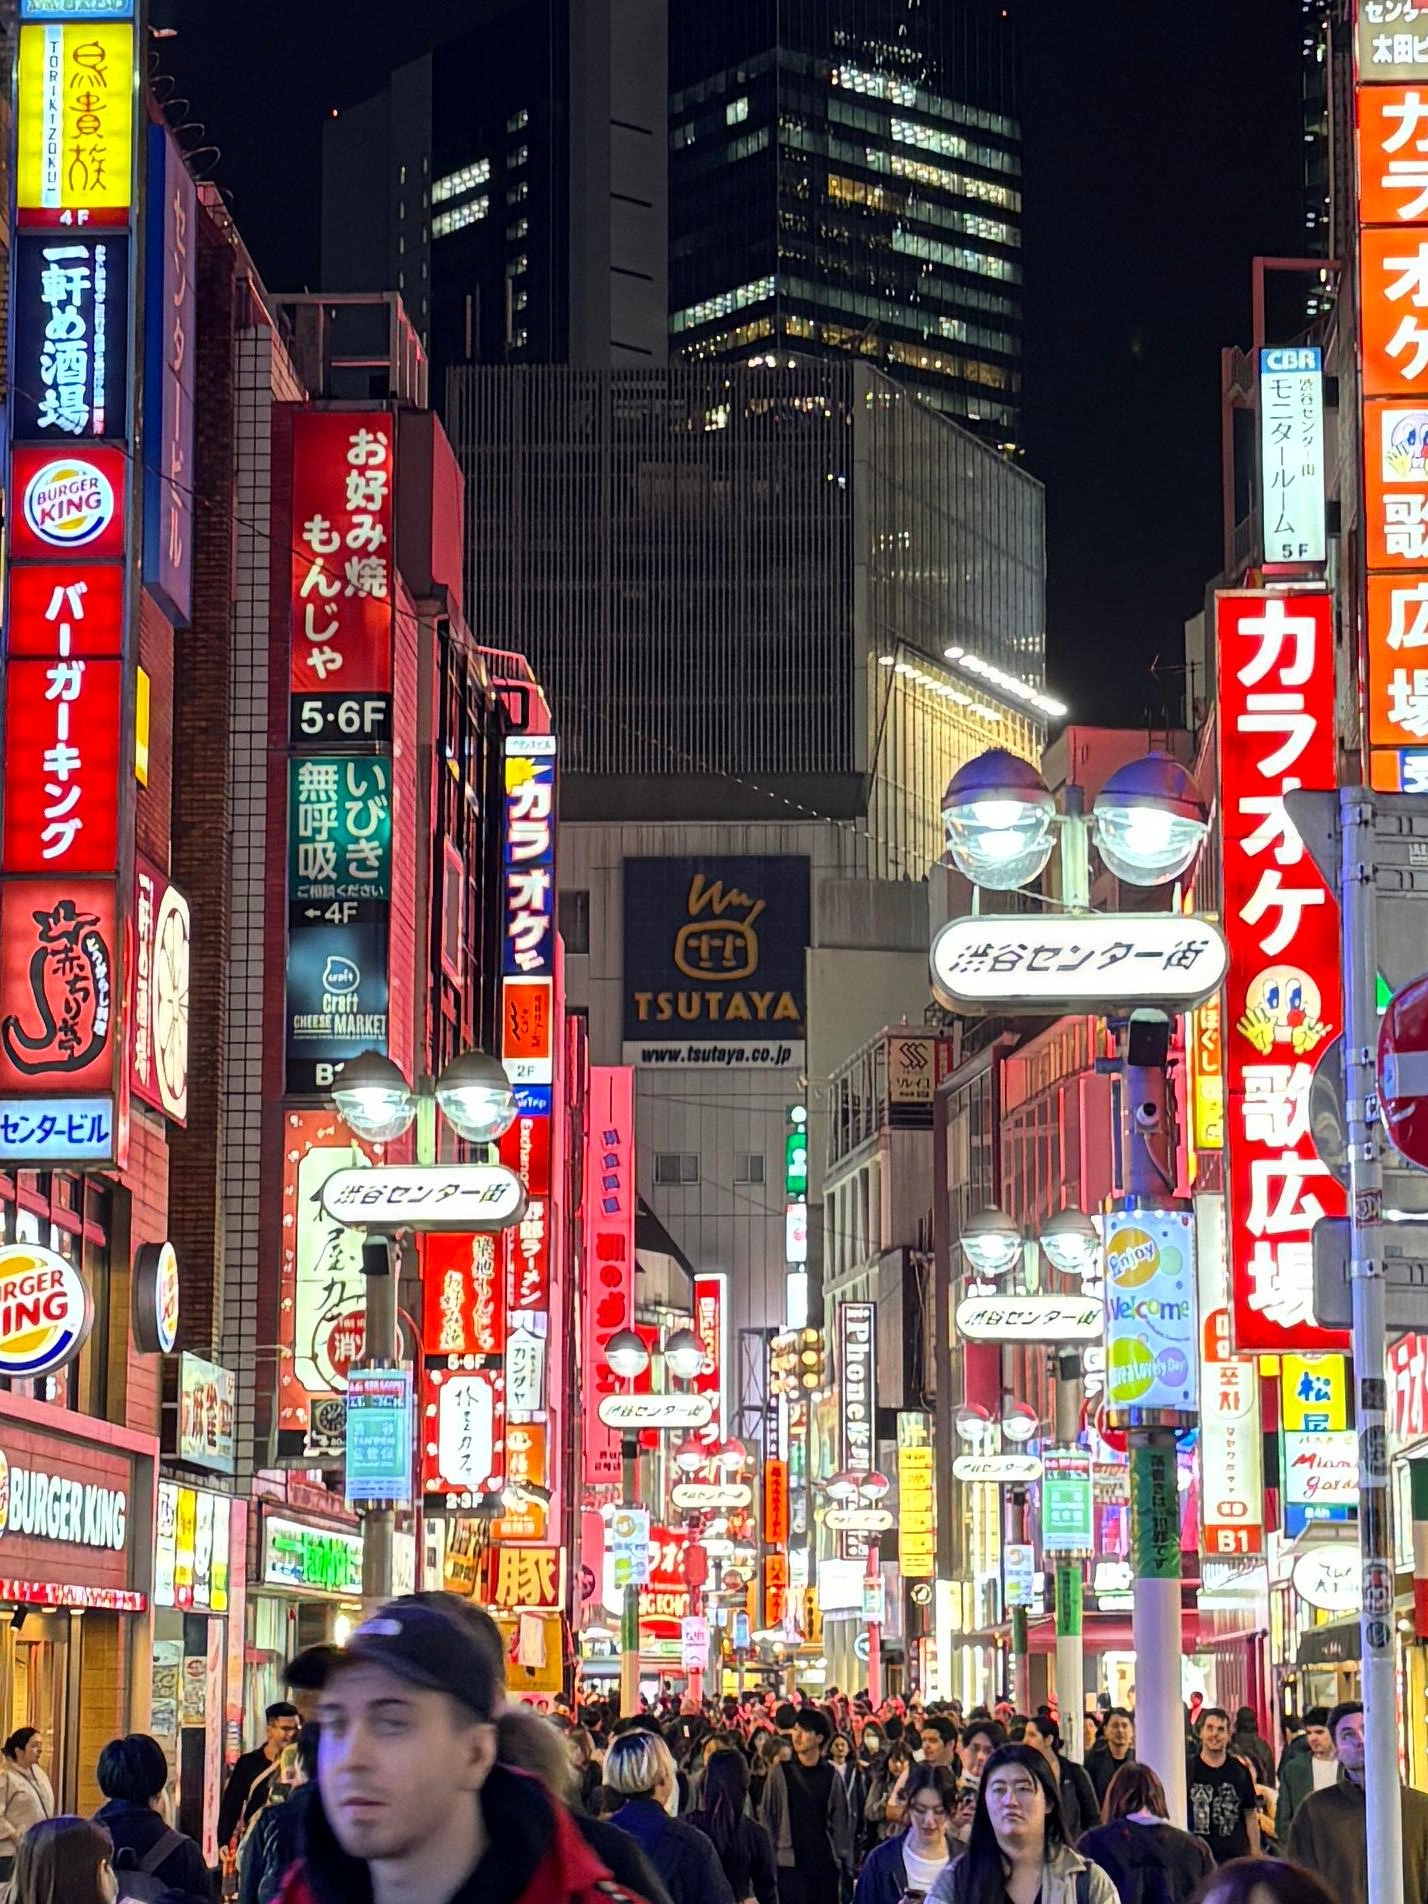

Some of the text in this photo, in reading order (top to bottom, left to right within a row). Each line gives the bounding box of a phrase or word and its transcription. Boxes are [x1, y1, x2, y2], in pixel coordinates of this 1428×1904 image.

[59, 208, 90, 226] 4F
[37, 244, 91, 436] 一軒め酒場
[1266, 351, 1316, 370] CBR
[1268, 377, 1295, 536] モニタールーム
[36, 476, 99, 506] BURGER
[38, 496, 103, 529] KING
[343, 427, 389, 599] お好み焼
[1281, 543, 1310, 560] 5F
[299, 513, 344, 680] もんじゃ
[40, 580, 88, 860] バーガーキング
[1236, 599, 1326, 957] カラオケ
[297, 761, 339, 881] 無呼吸
[344, 761, 388, 880] いびき
[324, 901, 359, 924] 4F
[947, 939, 1210, 974] 渋谷センター街
[321, 991, 361, 1015] Craft
[633, 991, 801, 1021] TSUTAYA
[292, 1013, 387, 1036] CHEESE MARKET
[1199, 1001, 1222, 1073] ほぐし
[640, 1044, 792, 1066] www.tsutaya.co.jp
[516, 1064, 536, 1078] 2F
[0, 1115, 111, 1145] センタービル
[333, 1182, 511, 1206] 渋谷センター街
[1107, 1240, 1155, 1278] Enjoy
[1290, 1453, 1360, 1468] Miam
[8, 1467, 127, 1551] BURGER KING
[1216, 1529, 1250, 1554] B1
[495, 1547, 557, 1607] 豚
